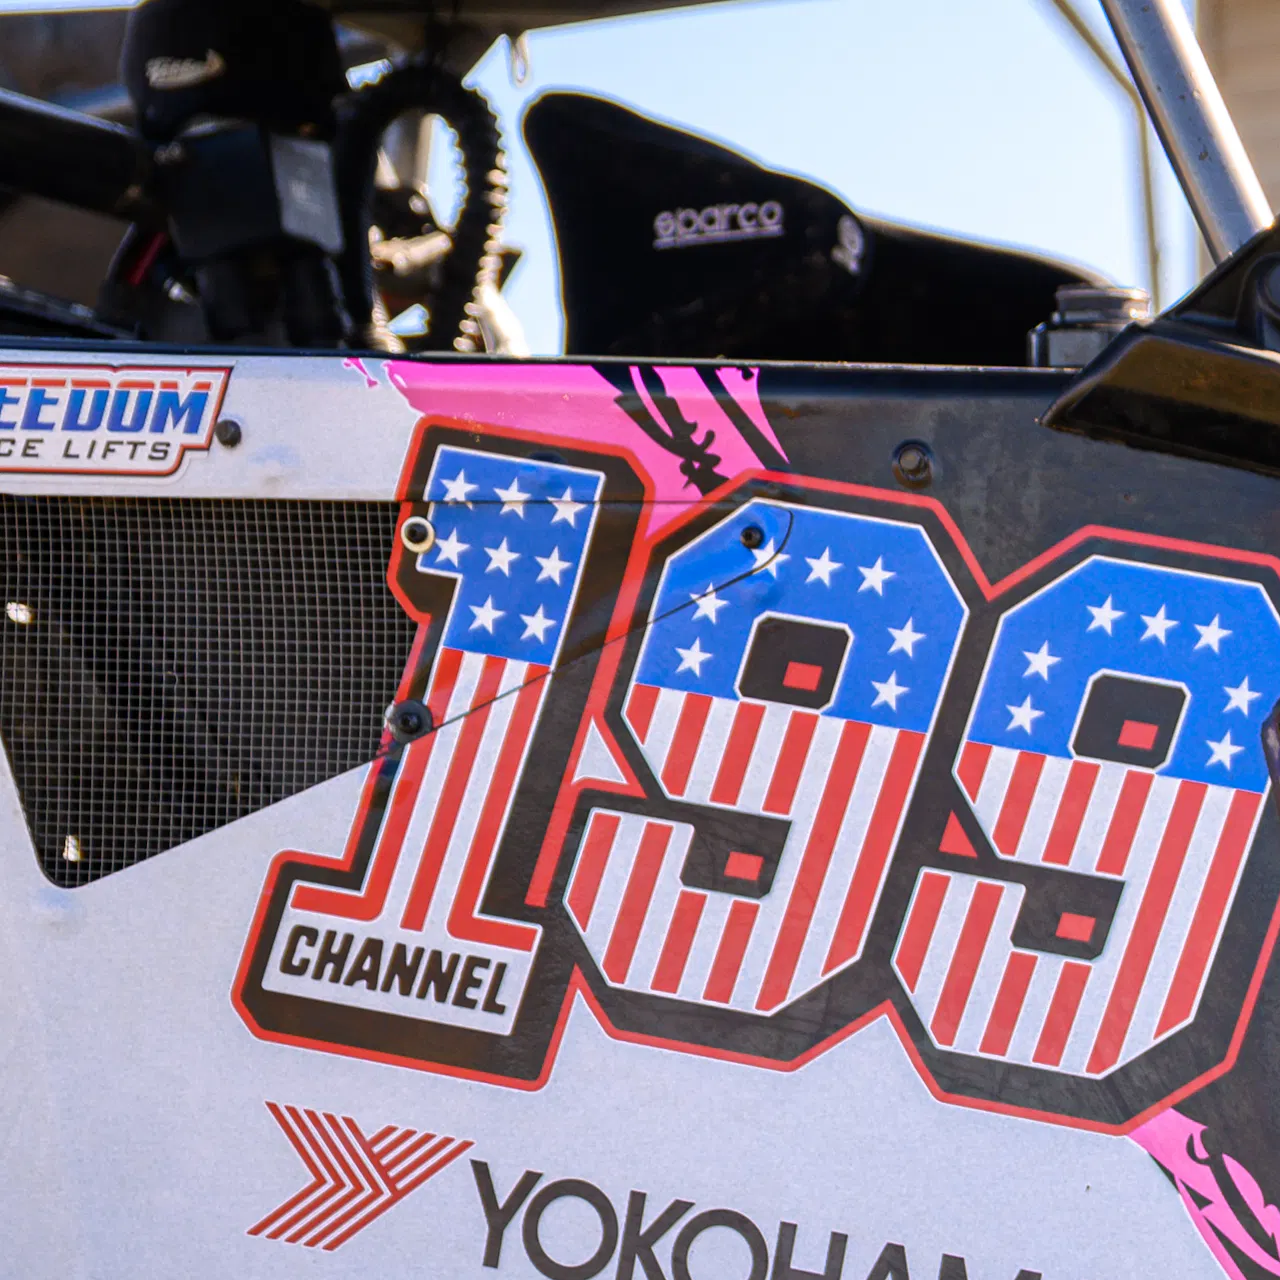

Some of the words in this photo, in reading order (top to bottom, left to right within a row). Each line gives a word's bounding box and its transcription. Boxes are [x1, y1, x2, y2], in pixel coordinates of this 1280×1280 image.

[652, 201, 784, 239] sparco
[62, 439, 171, 460] LIFTS
[279, 924, 508, 1015] CHANNEL
